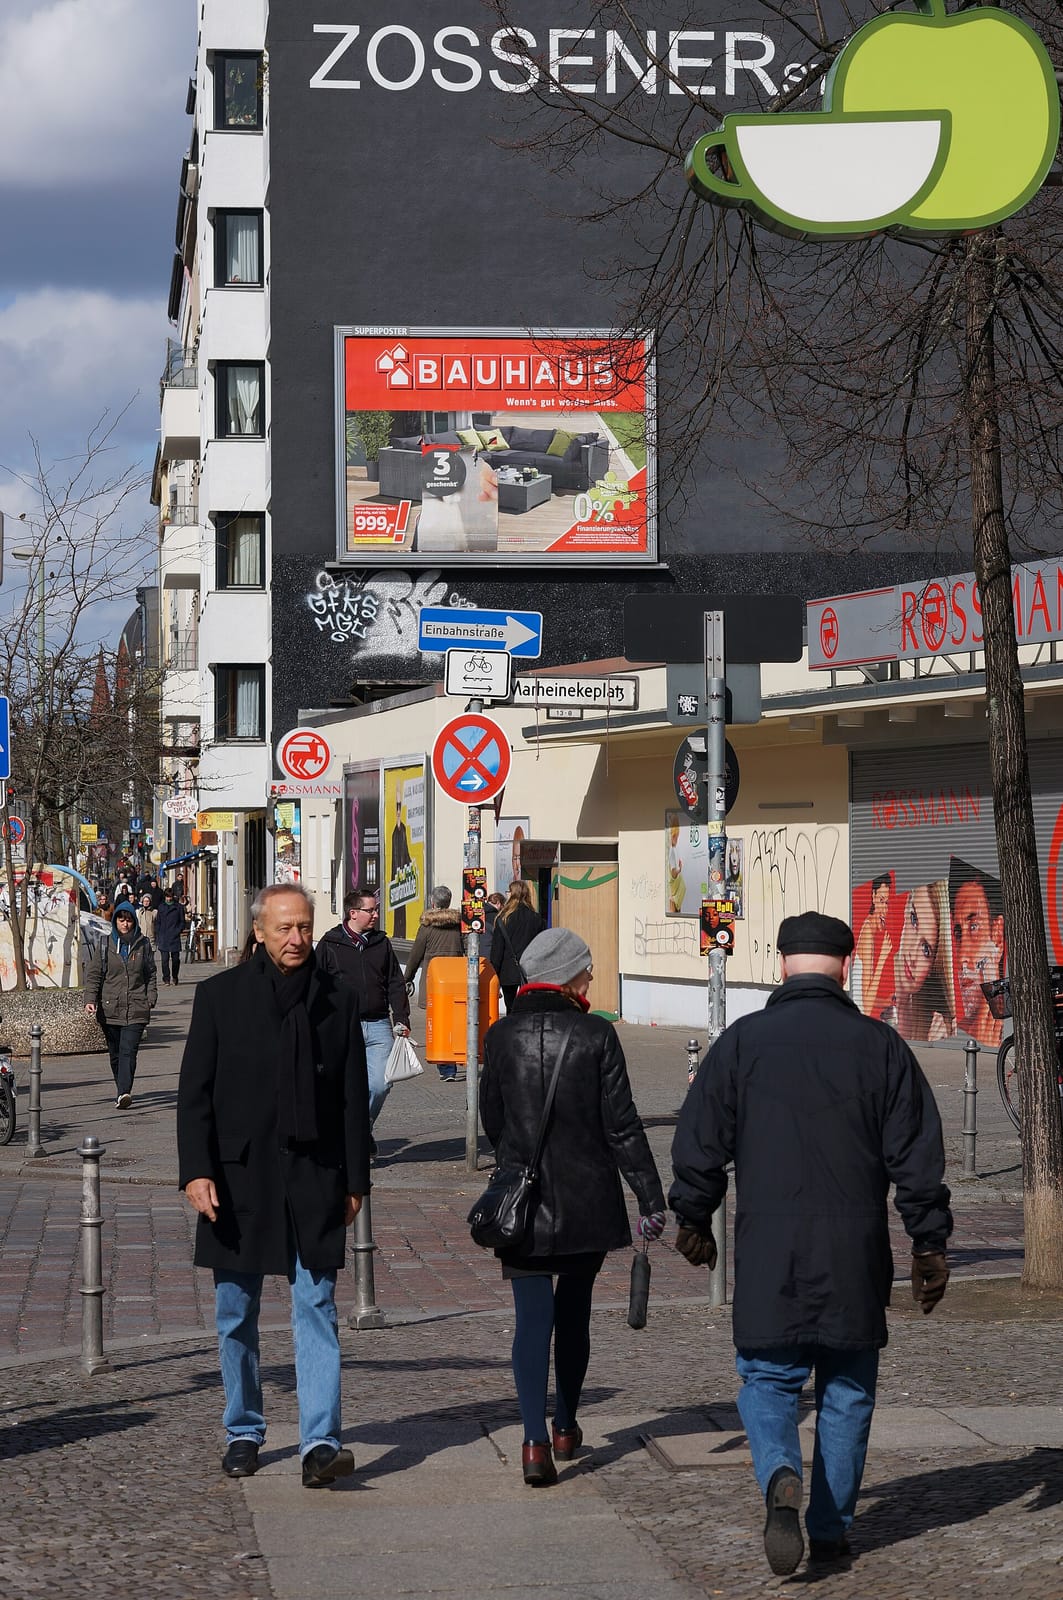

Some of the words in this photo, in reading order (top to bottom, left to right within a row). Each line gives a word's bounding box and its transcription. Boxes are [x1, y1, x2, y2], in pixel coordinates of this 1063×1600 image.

[310, 24, 779, 96] ZOSSENER
[354, 326, 408, 336] SUPERPOSTER
[418, 359, 614, 386] BAUHAUS
[506, 398, 537, 407] Wenn's
[540, 398, 555, 408] gut
[433, 452, 451, 476] 3
[574, 493, 614, 523] 0%
[425, 624, 504, 638] Einbahnstraße
[679, 774, 696, 799] EASY
[871, 786, 982, 830] ROSSMANN
[716, 901, 735, 914] SOUL
